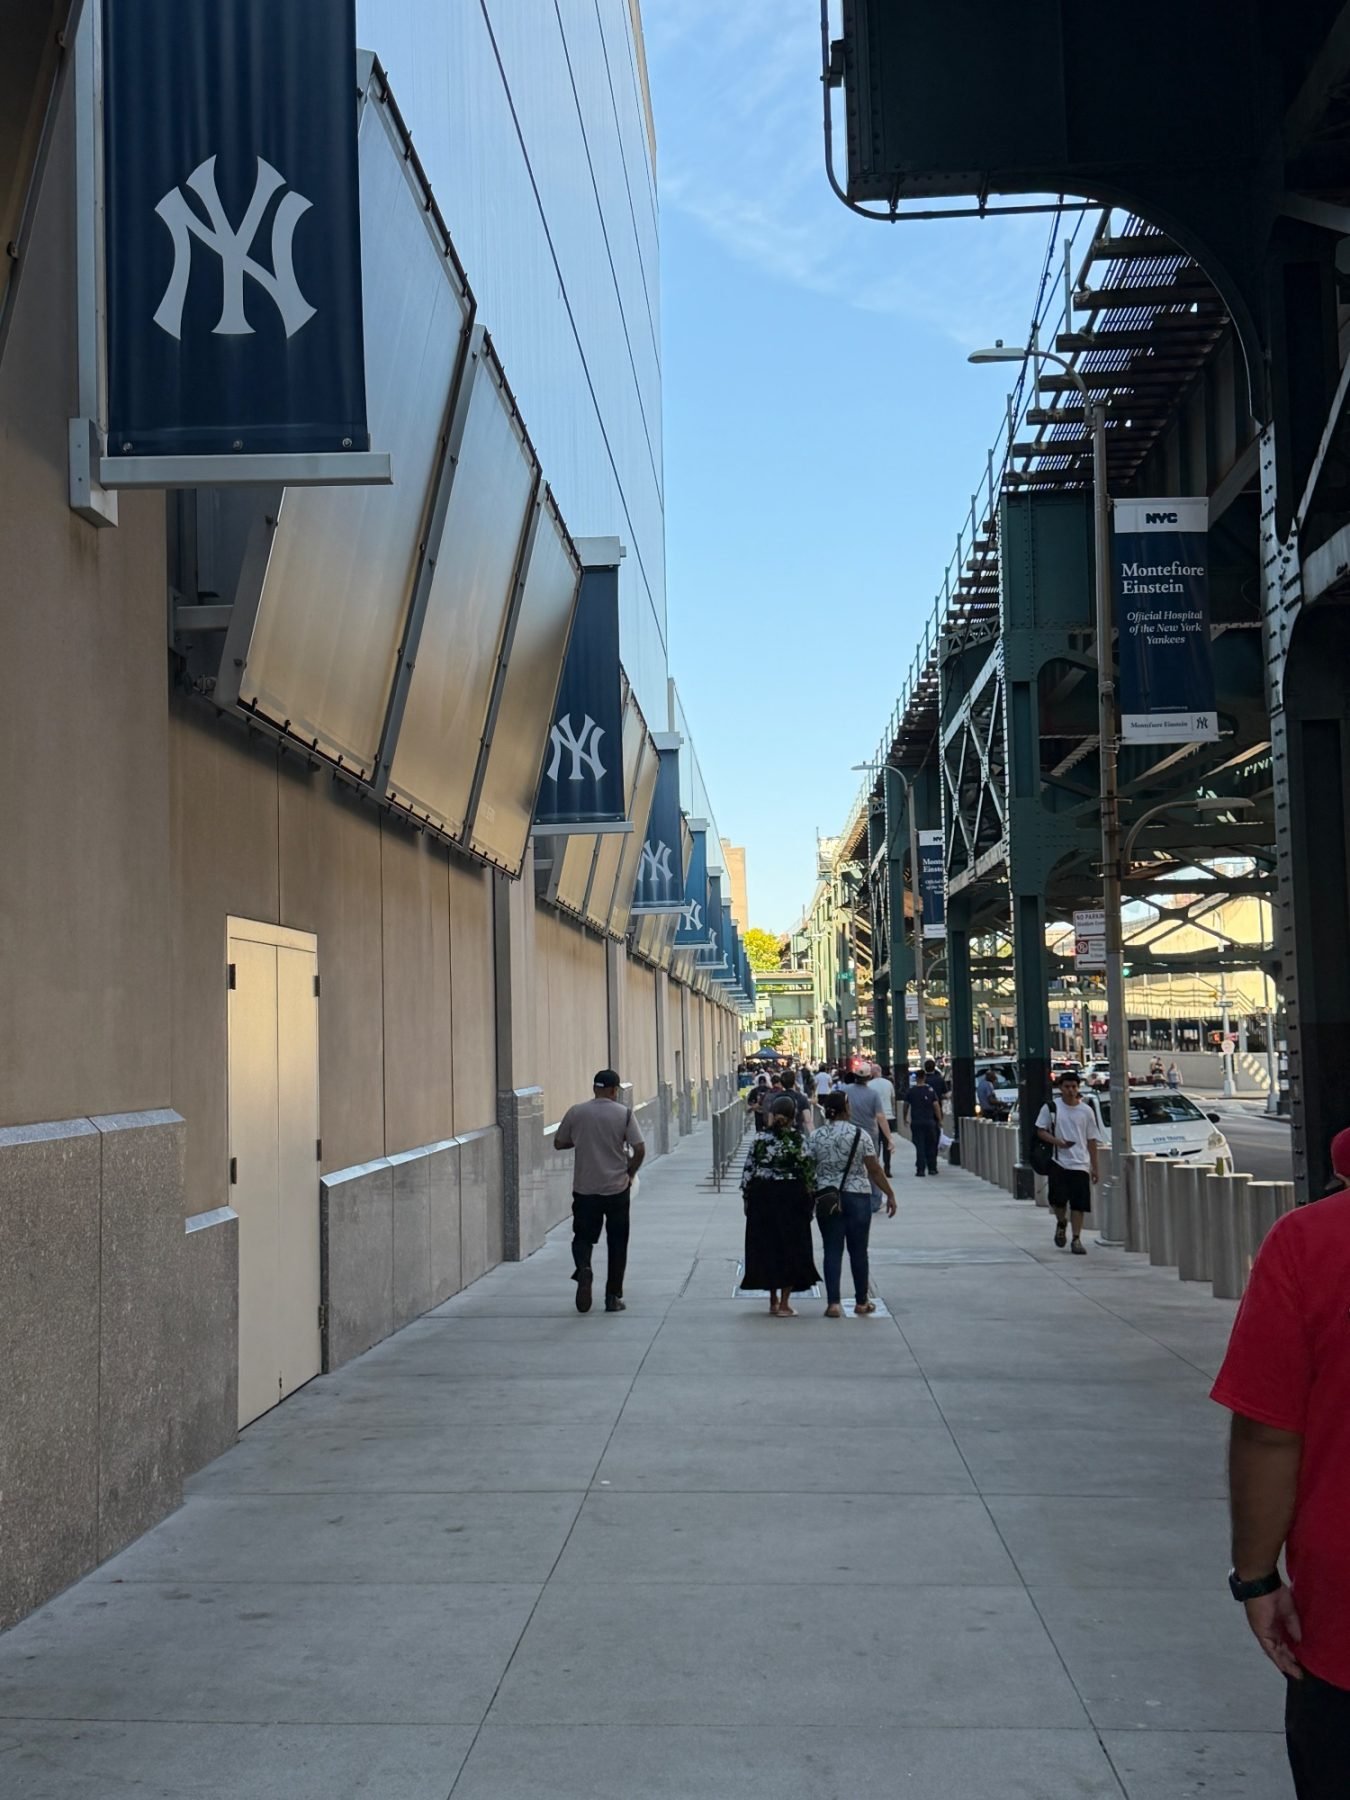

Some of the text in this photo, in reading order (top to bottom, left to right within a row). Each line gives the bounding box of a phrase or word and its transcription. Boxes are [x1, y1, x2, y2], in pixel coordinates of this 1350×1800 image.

[1145, 512, 1178, 524] NYC
[1121, 560, 1204, 577] Montefiore
[1122, 578, 1184, 594] Einstein
[1126, 610, 1203, 624] Official Hospital
[1128, 622, 1203, 636] of the New York
[1146, 634, 1186, 645] Yankees
